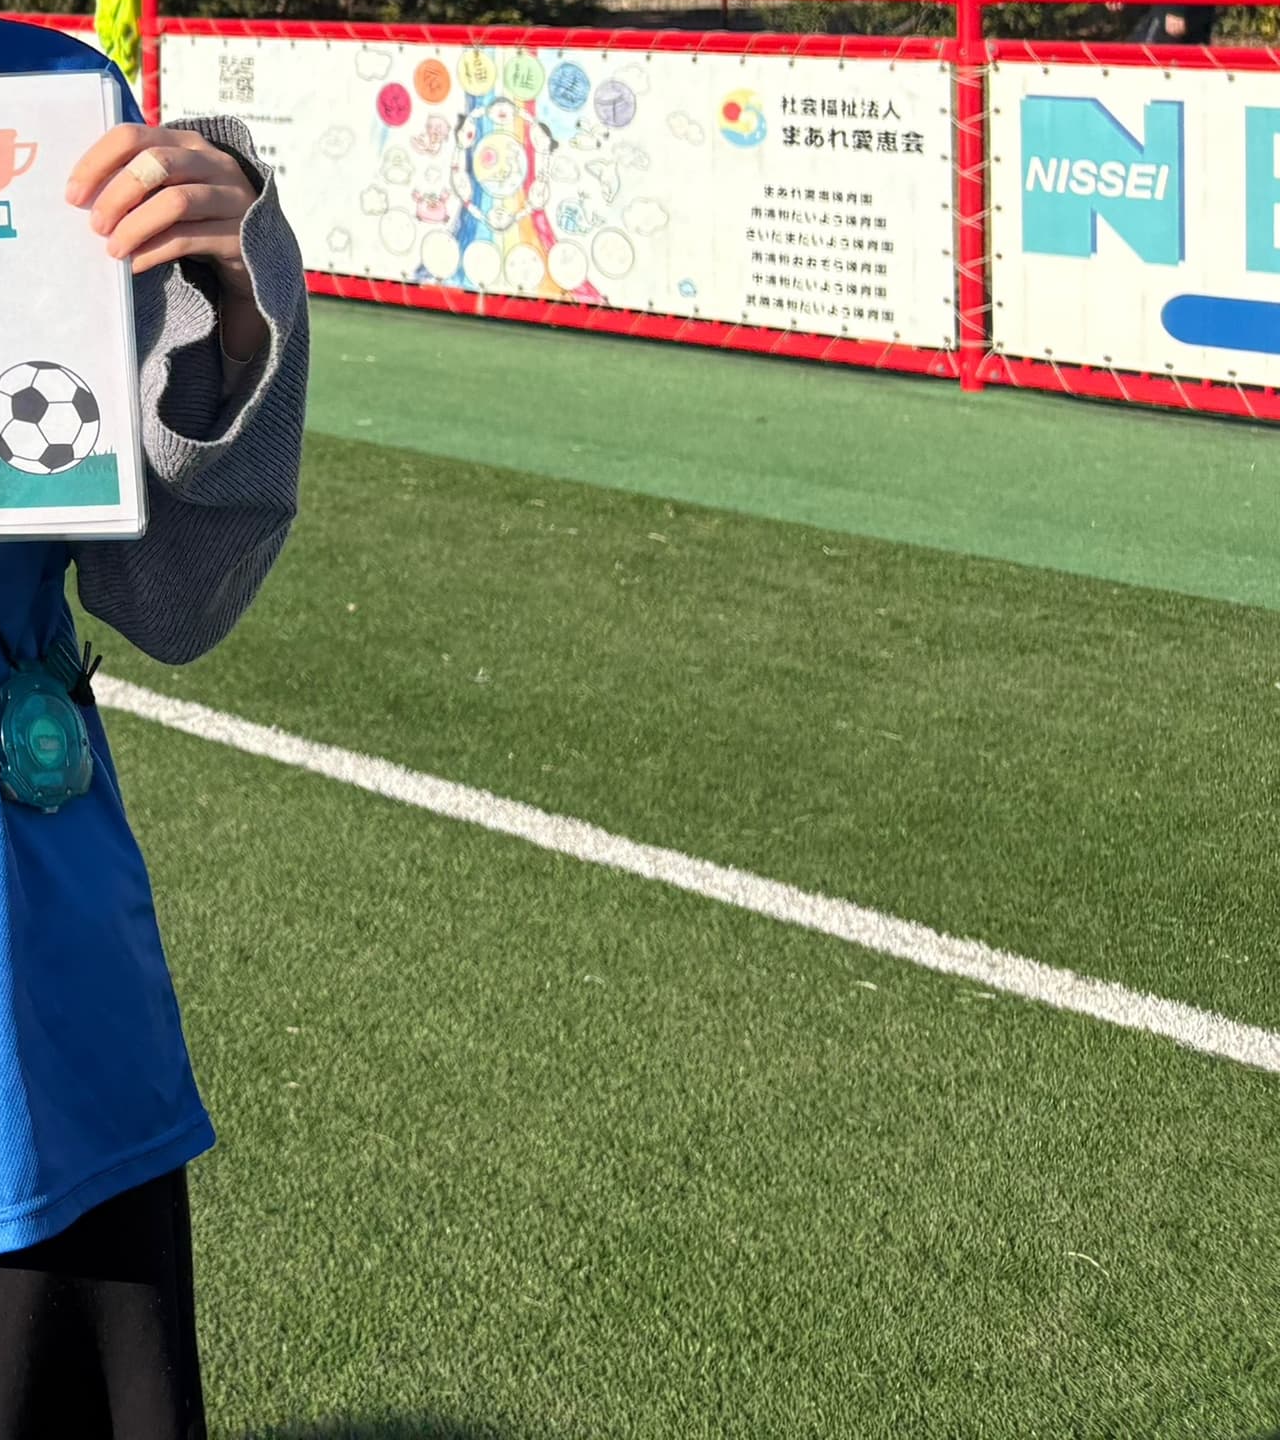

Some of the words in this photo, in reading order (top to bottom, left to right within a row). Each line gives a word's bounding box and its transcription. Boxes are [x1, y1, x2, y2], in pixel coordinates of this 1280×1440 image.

[781, 95, 901, 120] 社会福祉法人
[781, 125, 925, 154] まあれ愛恵会
[1025, 156, 1169, 201] NISSEI
